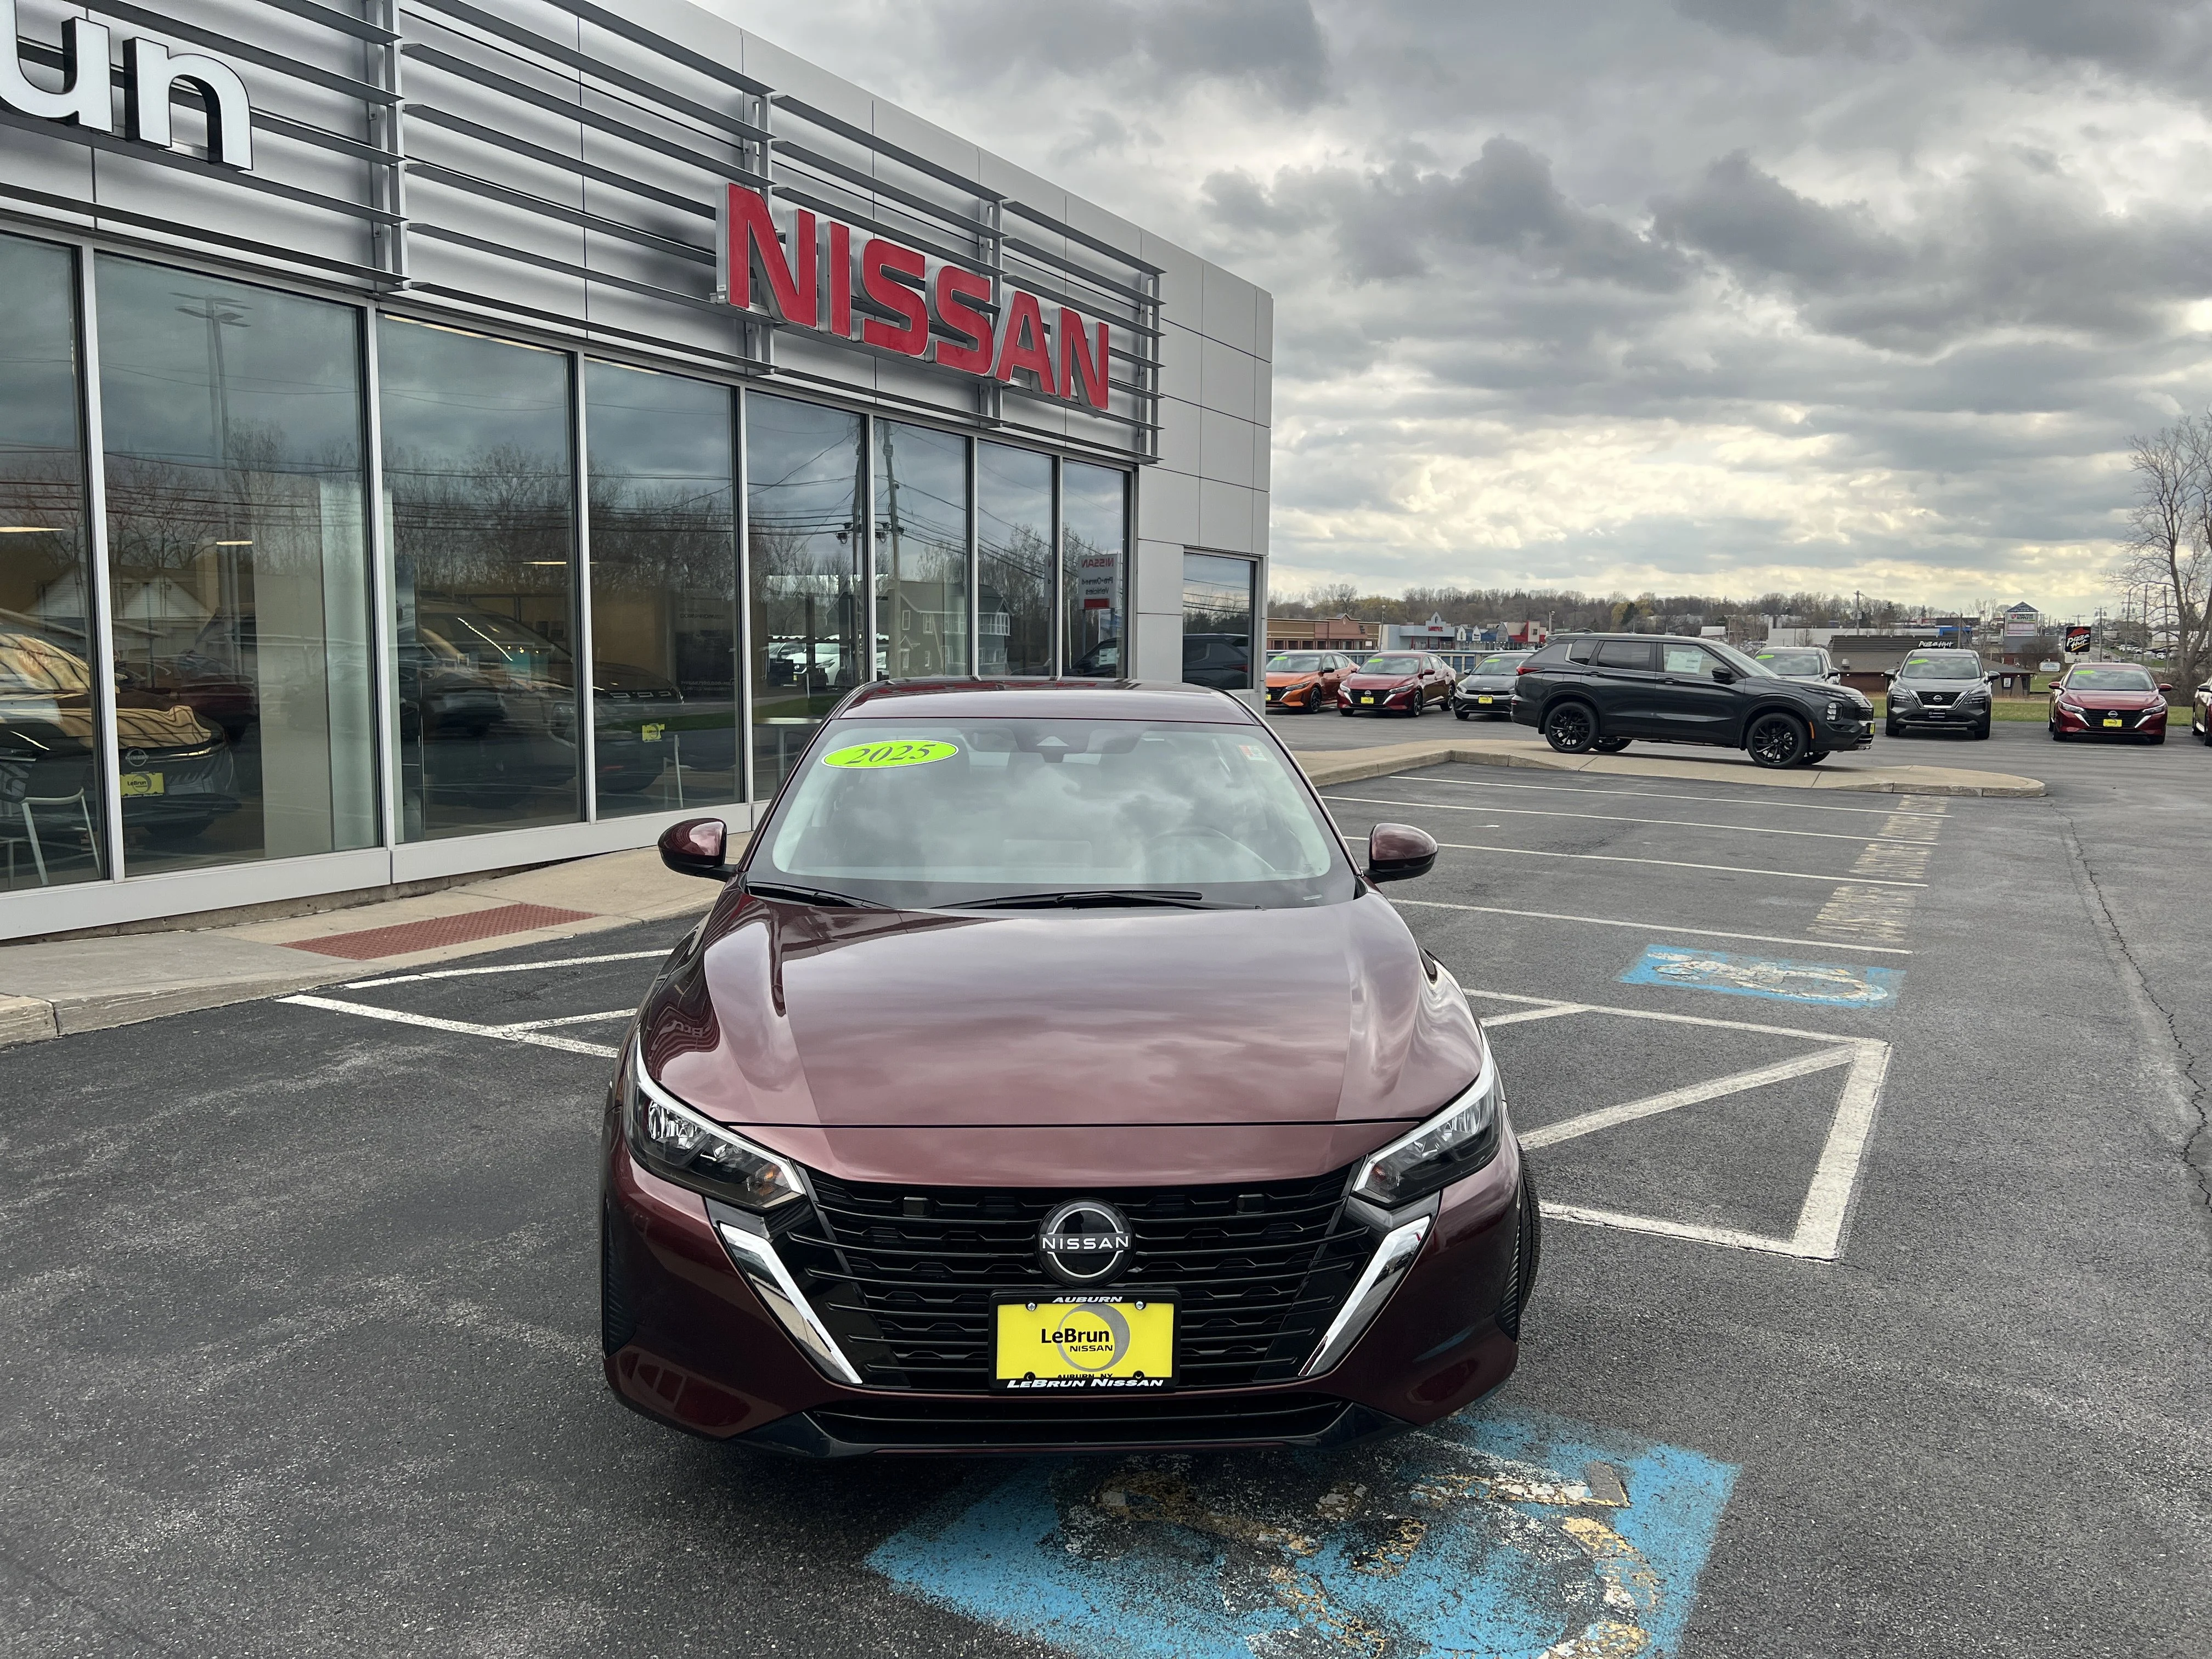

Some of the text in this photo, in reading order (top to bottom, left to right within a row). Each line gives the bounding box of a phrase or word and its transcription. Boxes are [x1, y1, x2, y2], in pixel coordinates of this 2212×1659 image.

[727, 182, 1109, 410] NISSAN
[2067, 634, 2090, 647] Pizza
[2071, 639, 2088, 648] Hut
[844, 744, 936, 764] 2025
[1042, 1235, 1129, 1250] NISSAN
[1041, 1328, 1110, 1344] LeBrun
